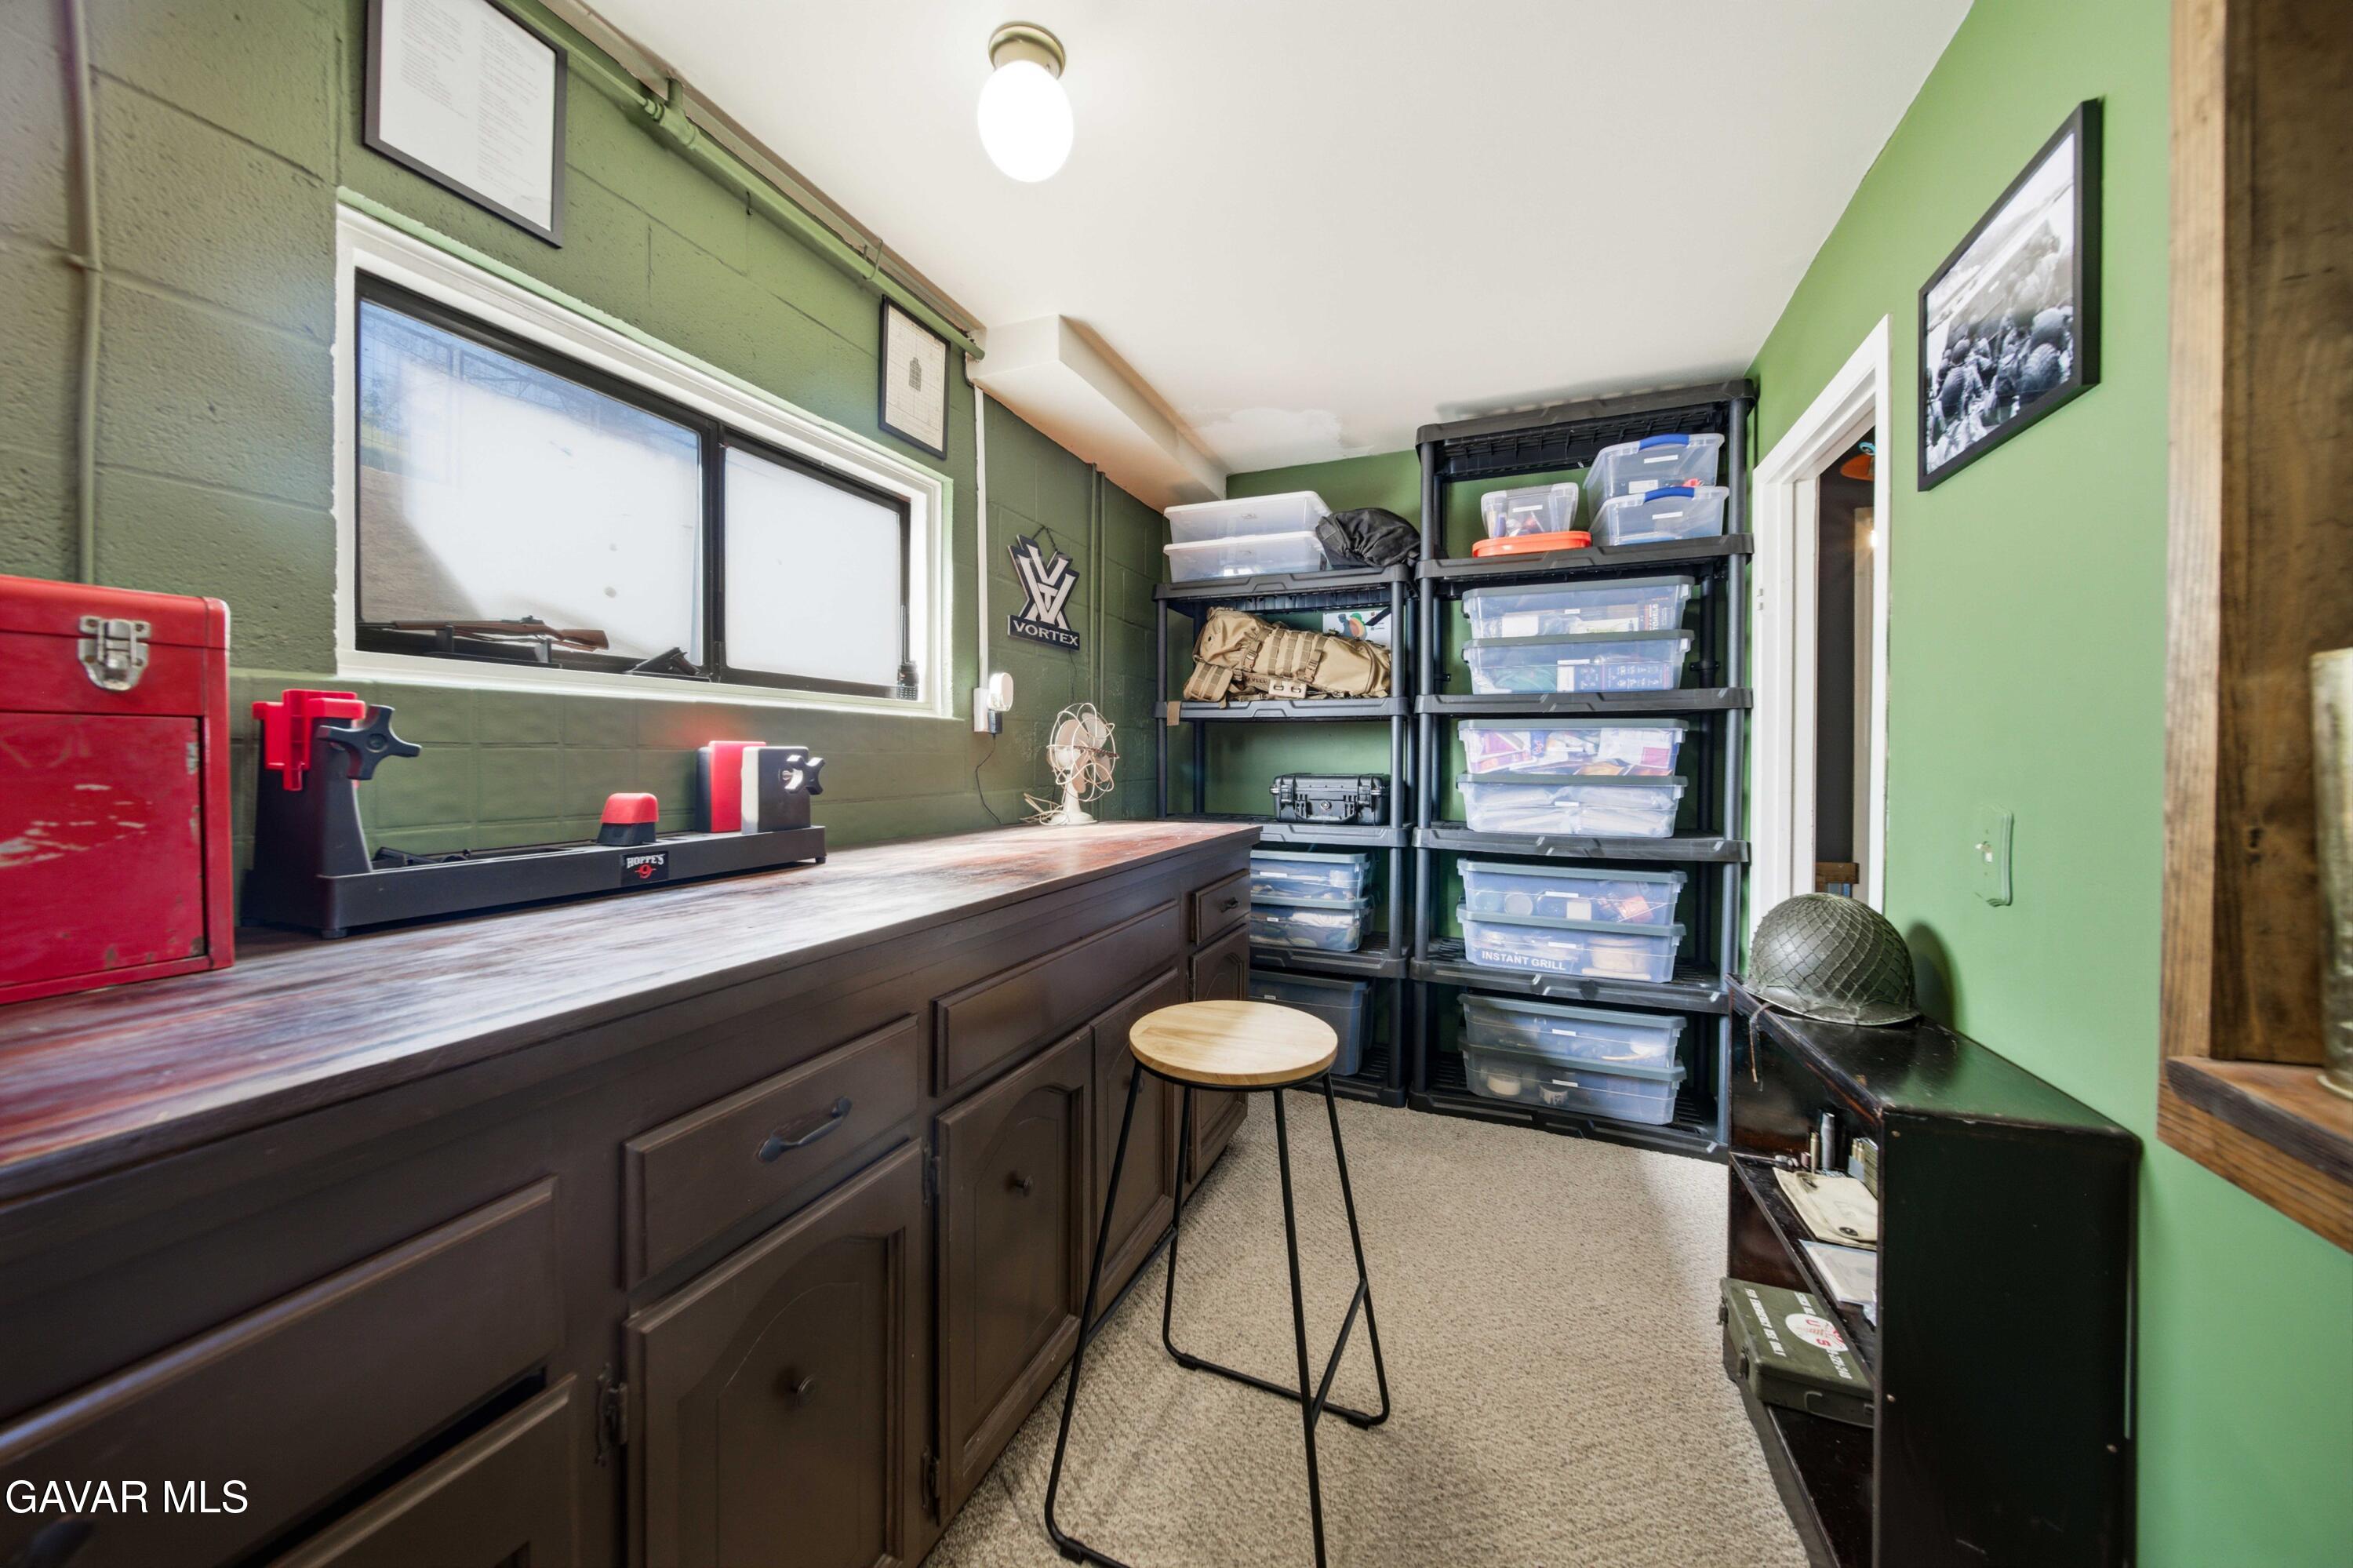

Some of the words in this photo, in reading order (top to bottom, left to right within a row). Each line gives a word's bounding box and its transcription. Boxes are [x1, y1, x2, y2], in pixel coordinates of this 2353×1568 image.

[1013, 620, 1079, 646] VORTEX
[626, 853, 666, 869] HOPPE'S
[639, 864, 653, 879] 9
[1482, 951, 1529, 966] INSTANT
[1531, 958, 1566, 970] GRILL
